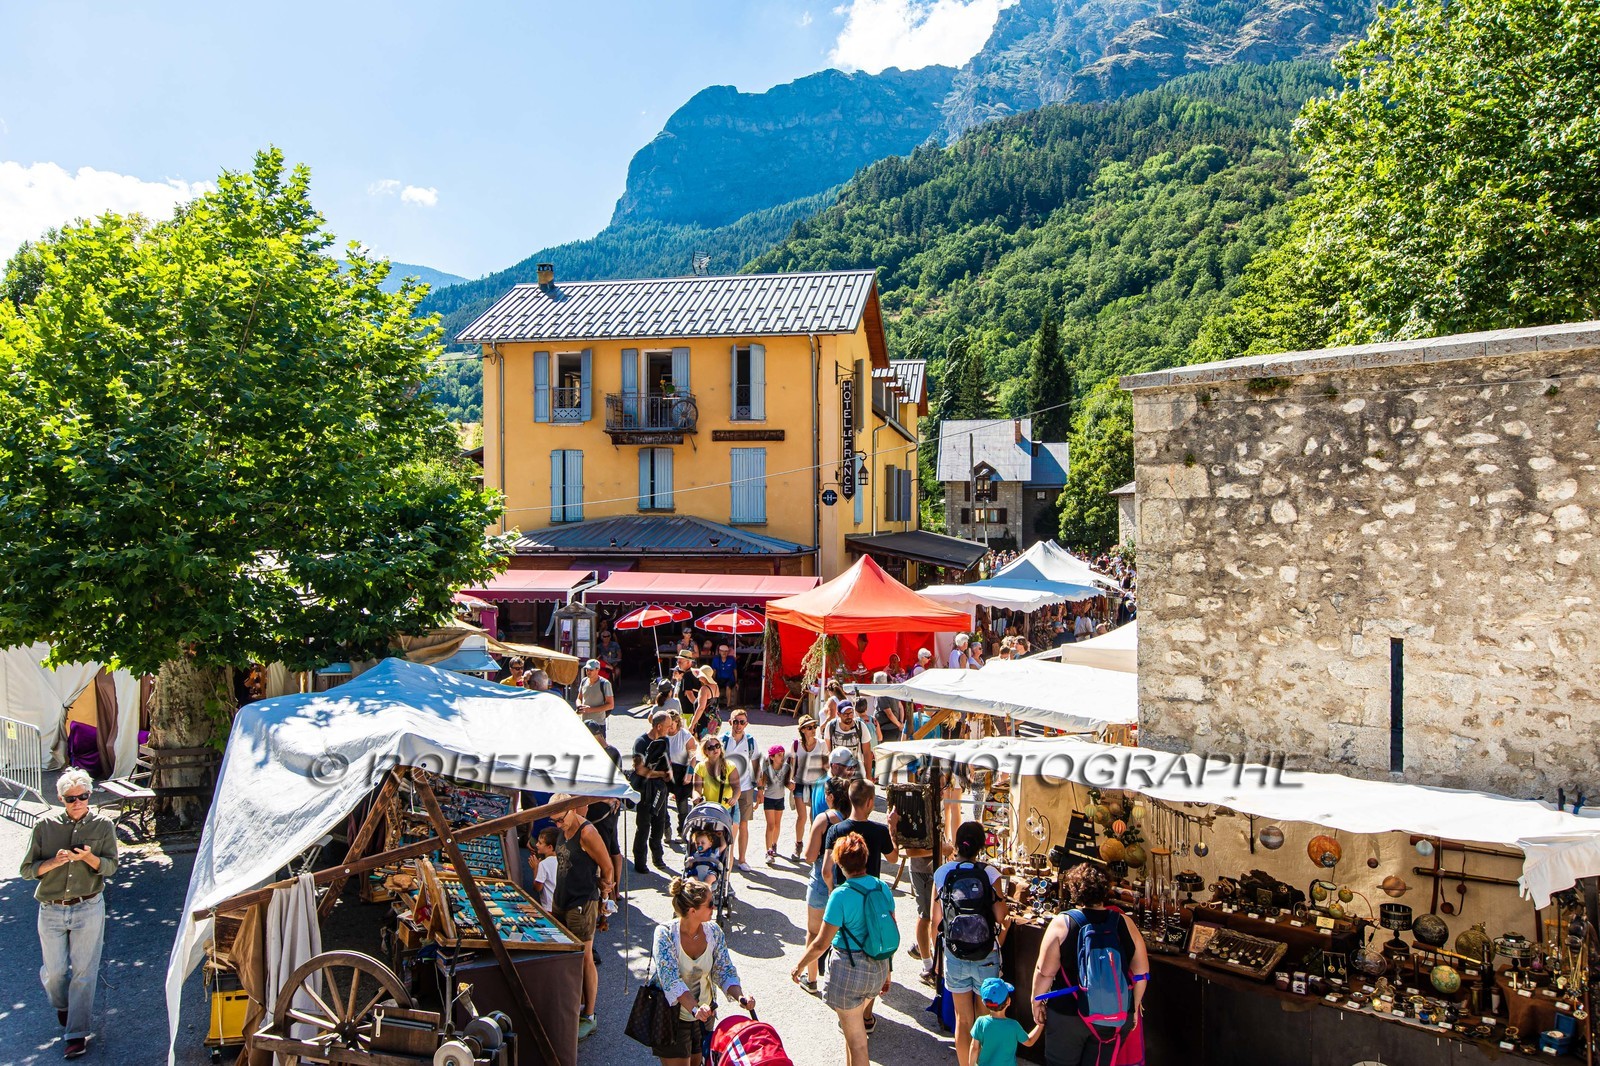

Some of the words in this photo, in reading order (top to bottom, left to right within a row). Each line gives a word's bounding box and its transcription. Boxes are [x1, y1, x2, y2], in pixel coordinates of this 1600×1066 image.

[843, 382, 852, 428] HOTEL
[843, 429, 853, 437] LE
[843, 440, 852, 494] FRANCE
